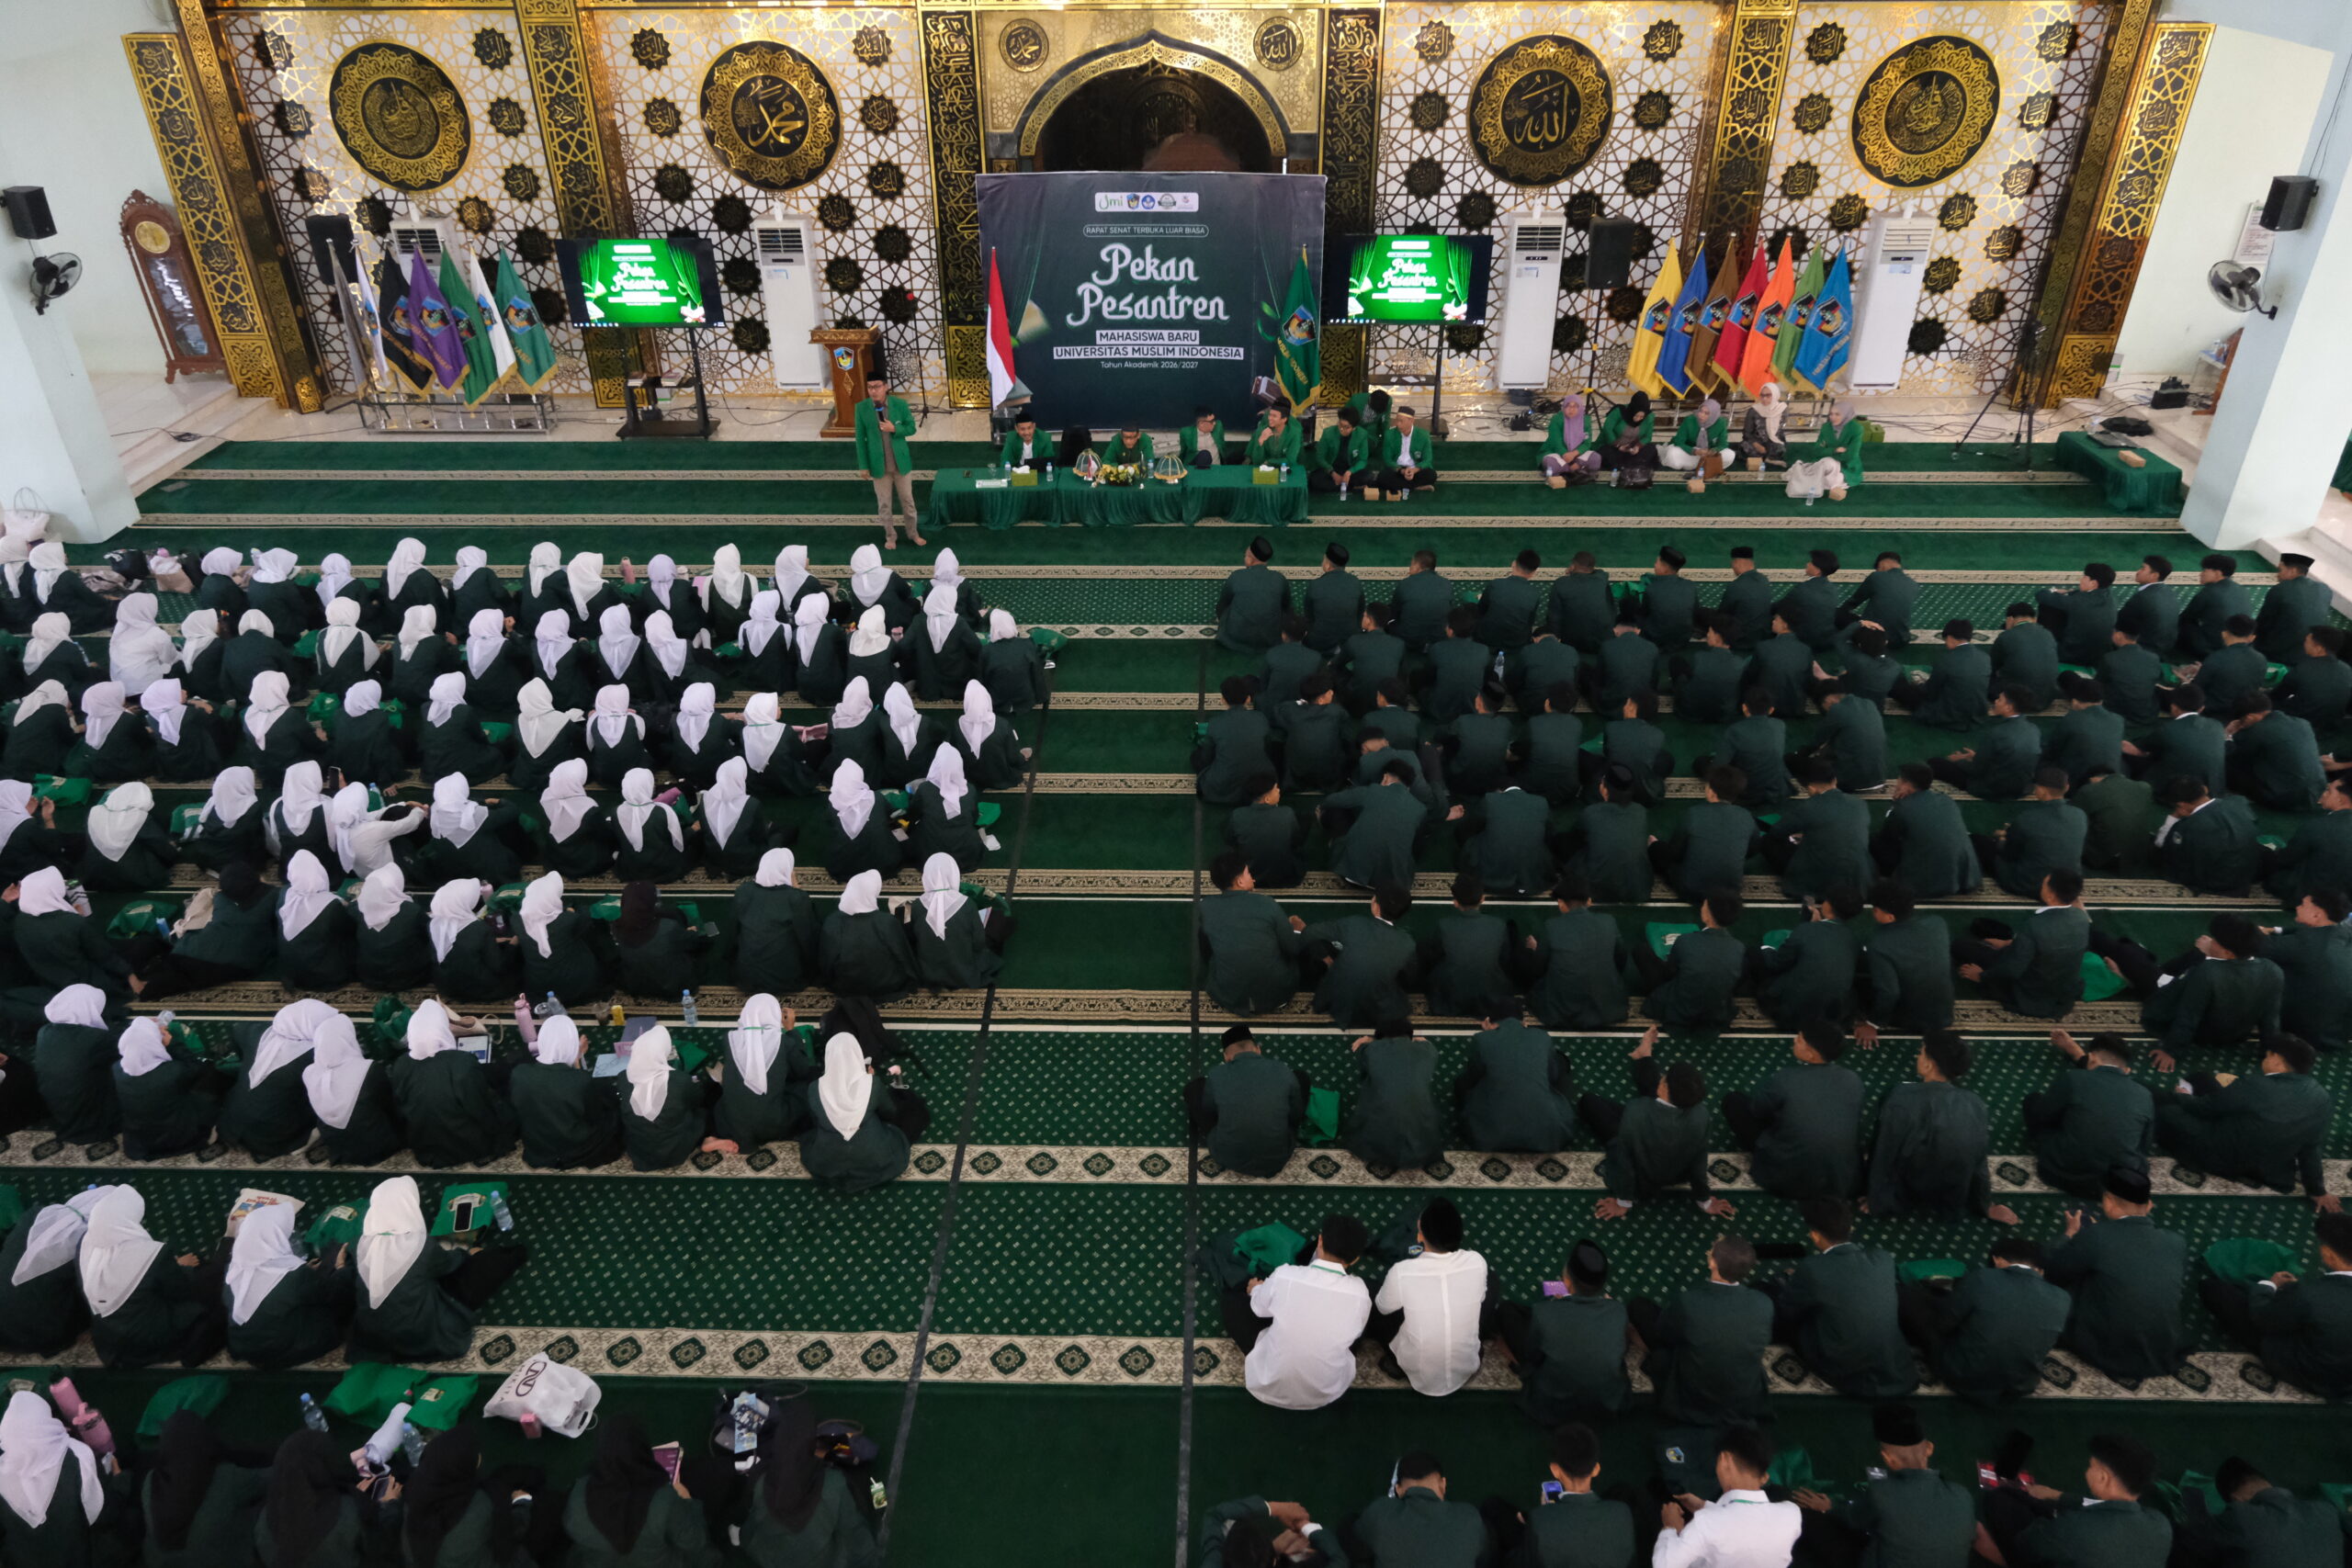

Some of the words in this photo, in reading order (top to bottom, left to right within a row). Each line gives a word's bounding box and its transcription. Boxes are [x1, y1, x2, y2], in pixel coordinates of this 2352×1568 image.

[1091, 243, 1200, 286] Pekan
[1066, 282, 1231, 326] Pesantren
[1099, 332, 1165, 343] MAHASISWA
[1167, 332, 1198, 342] BARU
[1055, 346, 1129, 358] UNIVERSITAS
[1131, 346, 1176, 356] MUSLIM
[1178, 346, 1242, 358] INDONESIA
[1100, 360, 1124, 369] Tahun
[1124, 360, 1159, 369] Akademik
[1159, 360, 1199, 369] 2026/2027
